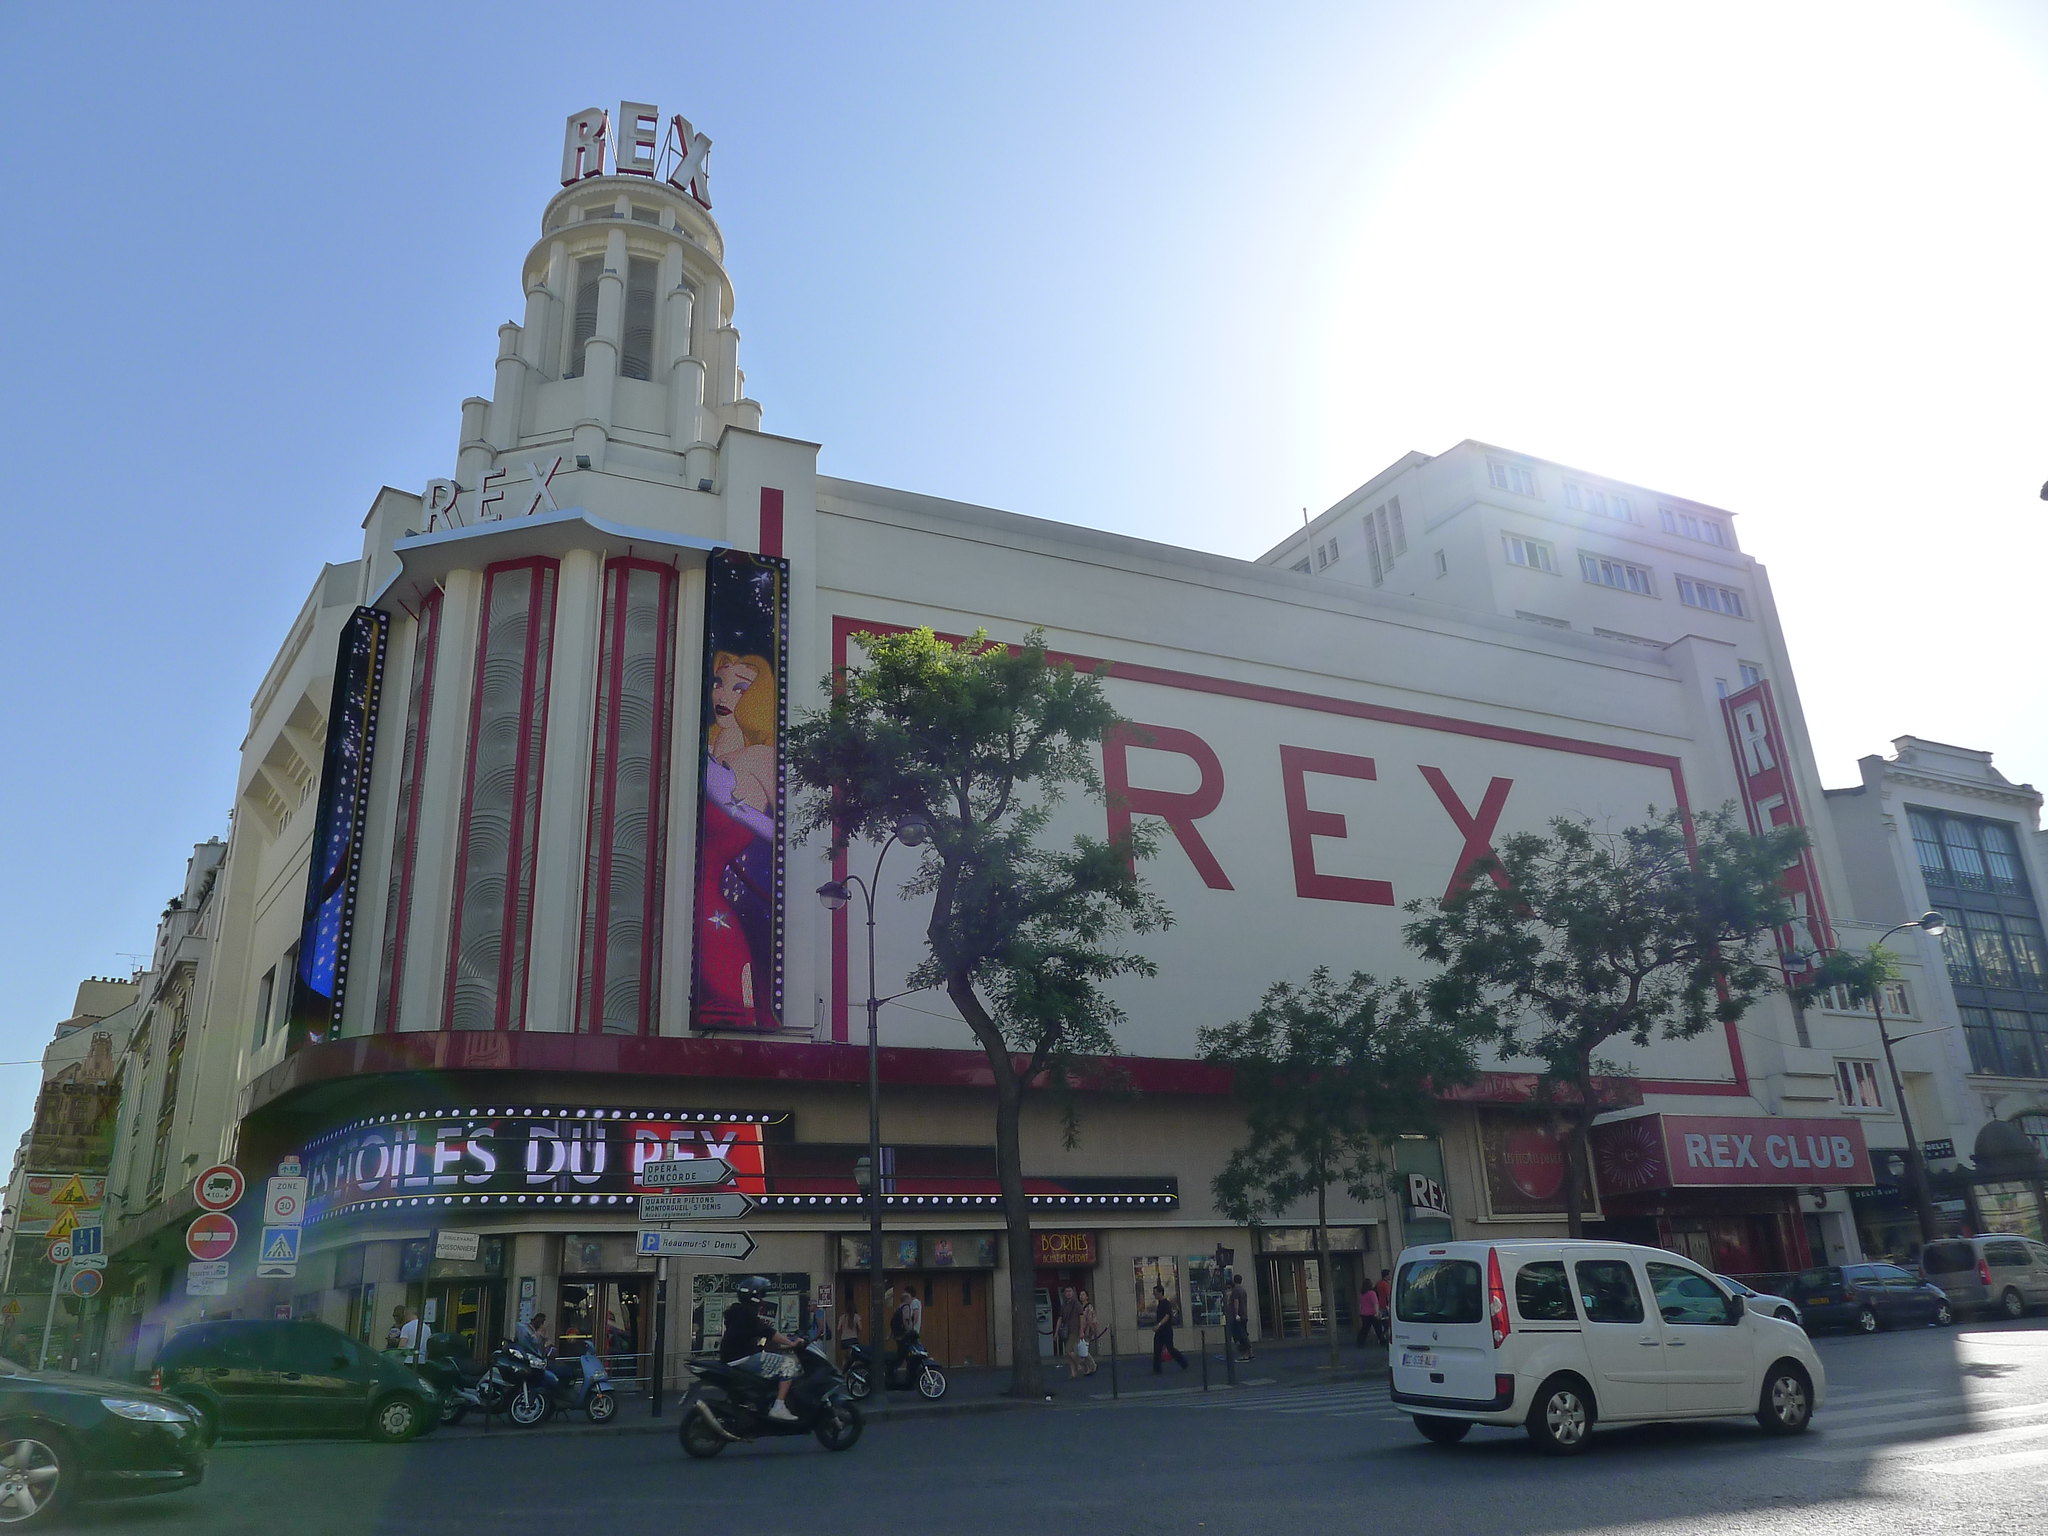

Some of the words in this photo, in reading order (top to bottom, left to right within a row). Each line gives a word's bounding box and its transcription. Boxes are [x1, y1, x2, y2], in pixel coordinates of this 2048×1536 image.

[560, 100, 713, 210] REX
[423, 456, 563, 534] REX
[1101, 721, 1537, 917] REX
[1734, 700, 1823, 974] REX
[92, 1031, 113, 1042] REX
[526, 1126, 606, 1185] DU
[633, 1129, 737, 1186] REX
[1684, 1132, 1760, 1169] REX
[1765, 1133, 1855, 1169] CLUB
[648, 1164, 678, 1173] OPÉRA
[647, 1172, 697, 1182] CONCORDE
[277, 1182, 298, 1190] ZONE
[1408, 1173, 1449, 1214] REX
[279, 1202, 291, 1210] 30
[645, 1197, 682, 1205] QUARTIER
[647, 1236, 656, 1247] P
[714, 1241, 737, 1249] Denis
[1041, 1233, 1088, 1251] BORNES
[54, 1246, 70, 1257] 30
